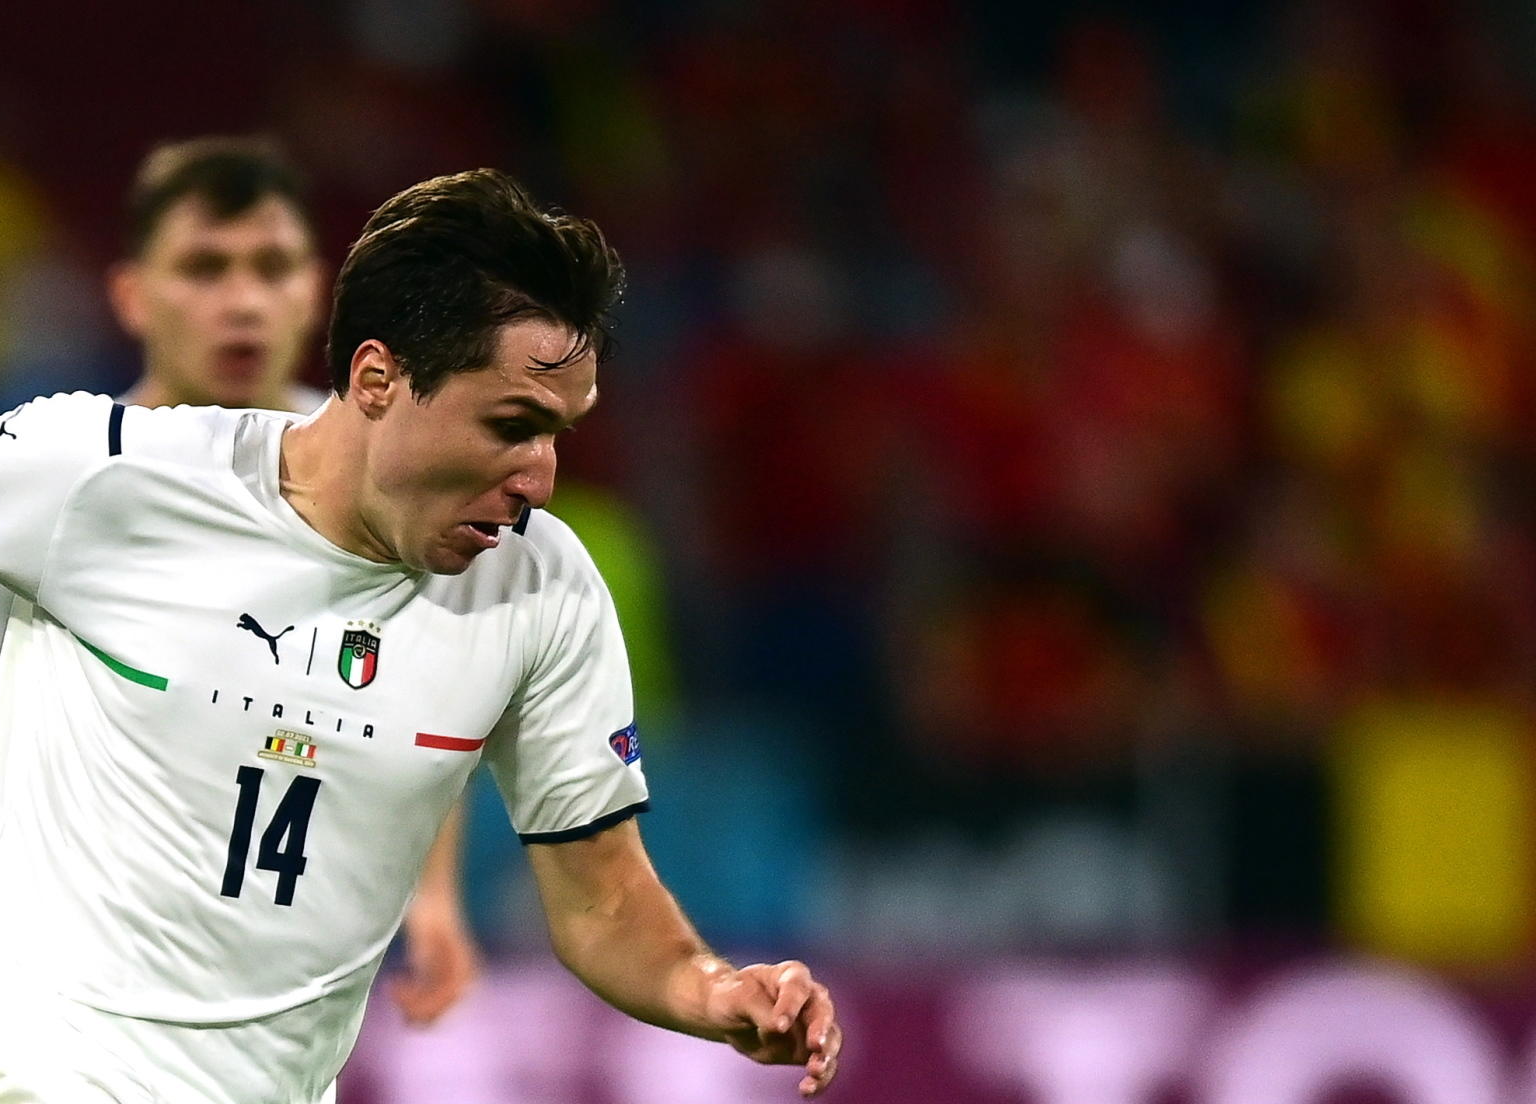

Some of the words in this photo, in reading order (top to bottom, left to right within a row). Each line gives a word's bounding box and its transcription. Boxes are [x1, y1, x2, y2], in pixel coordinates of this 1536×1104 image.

[346, 634, 377, 649] ITALIA
[212, 690, 374, 738] ITALIA
[221, 766, 321, 906] 14
